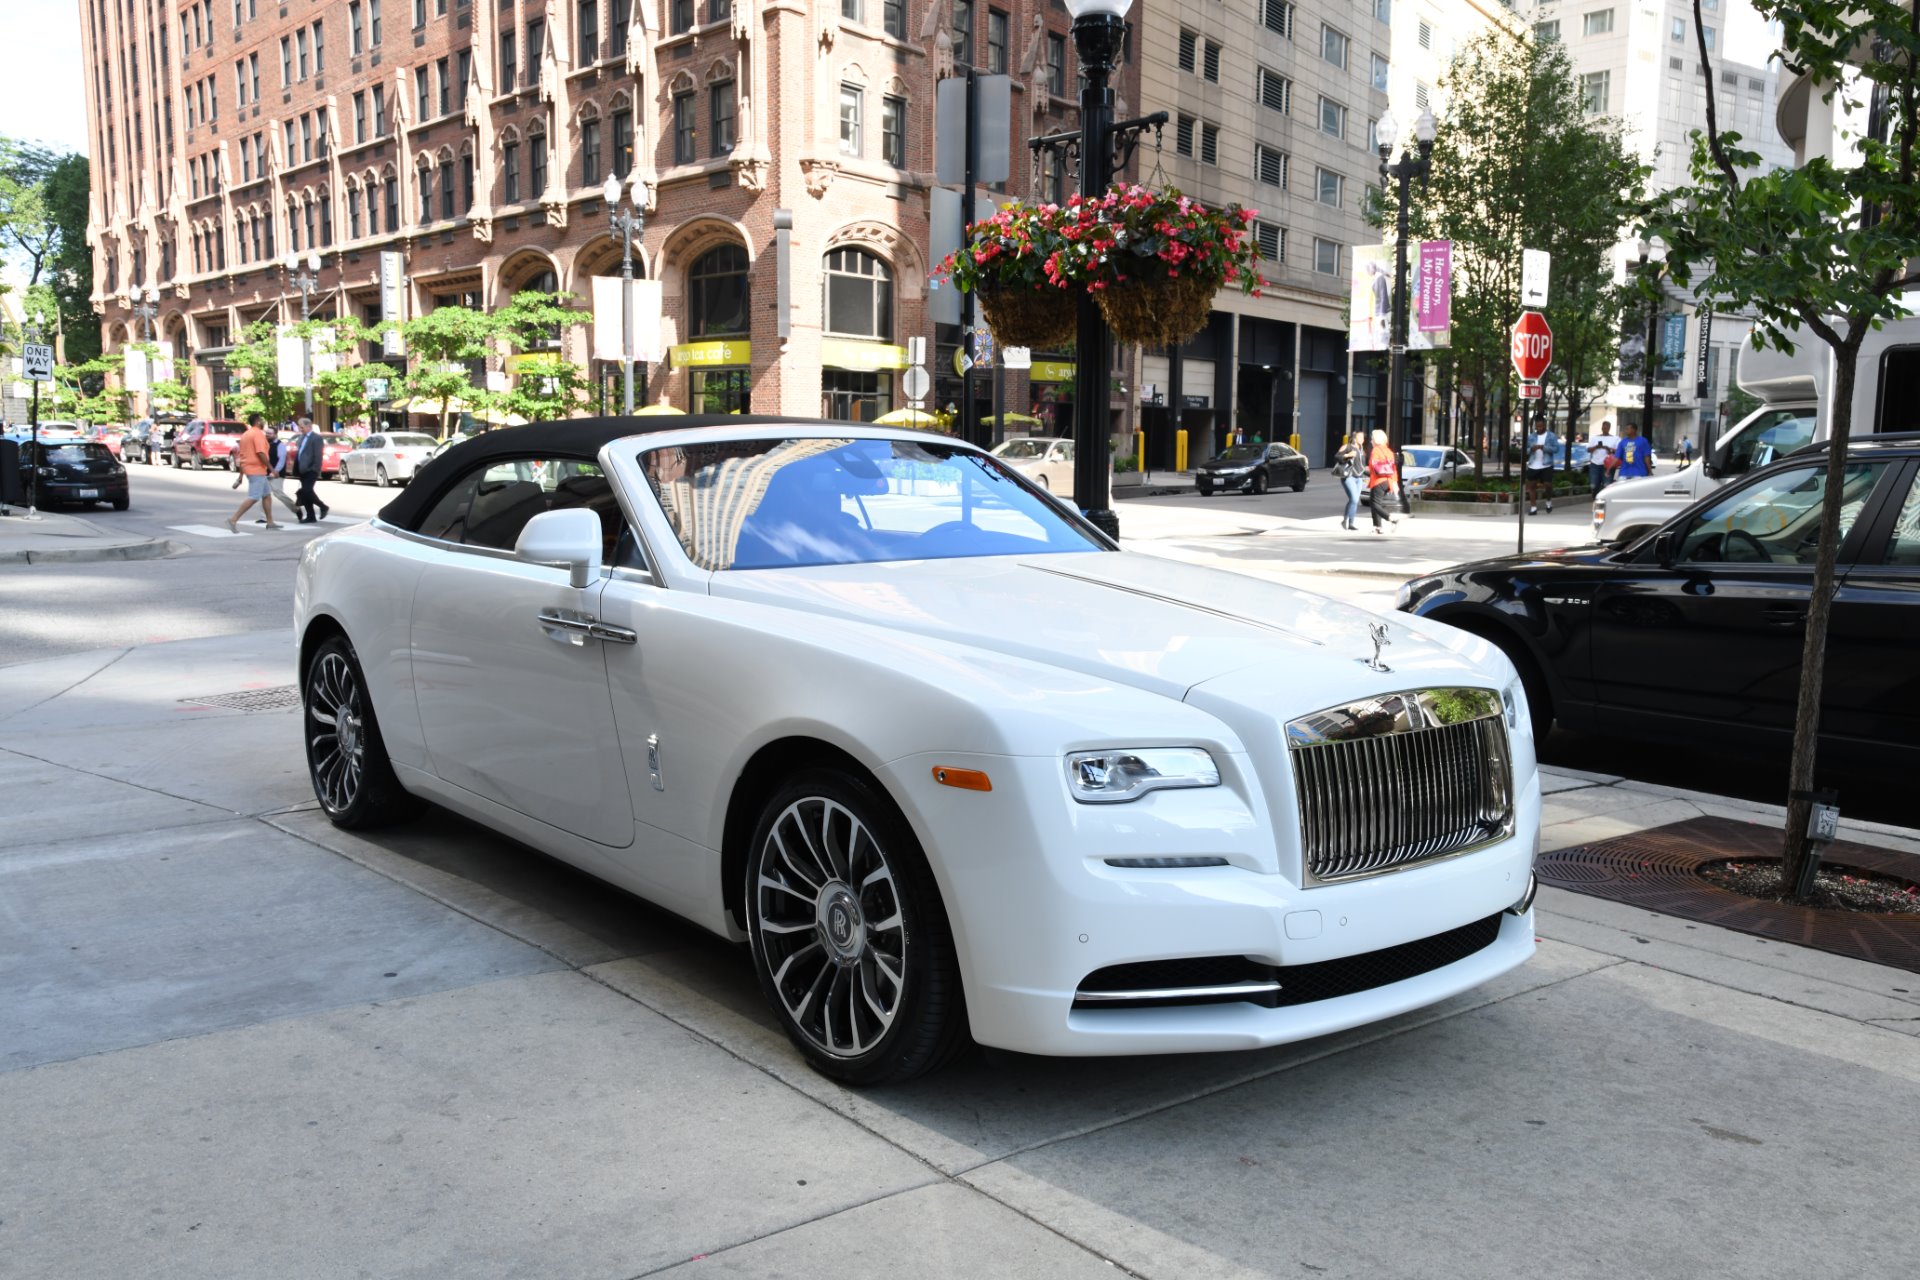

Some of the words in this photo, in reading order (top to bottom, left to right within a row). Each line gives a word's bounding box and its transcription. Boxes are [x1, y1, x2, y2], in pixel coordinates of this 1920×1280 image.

[1422, 258, 1433, 274] My
[1435, 257, 1445, 276] Her
[1423, 276, 1433, 314] Dreams
[1432, 278, 1444, 306] Story,
[26, 346, 49, 357] ONE
[707, 342, 732, 360] café
[1514, 332, 1550, 359] STOP
[26, 356, 49, 366] WAY
[1698, 361, 1707, 383] rack
[1521, 386, 1530, 396] ALL
[1530, 387, 1540, 396] WAY
